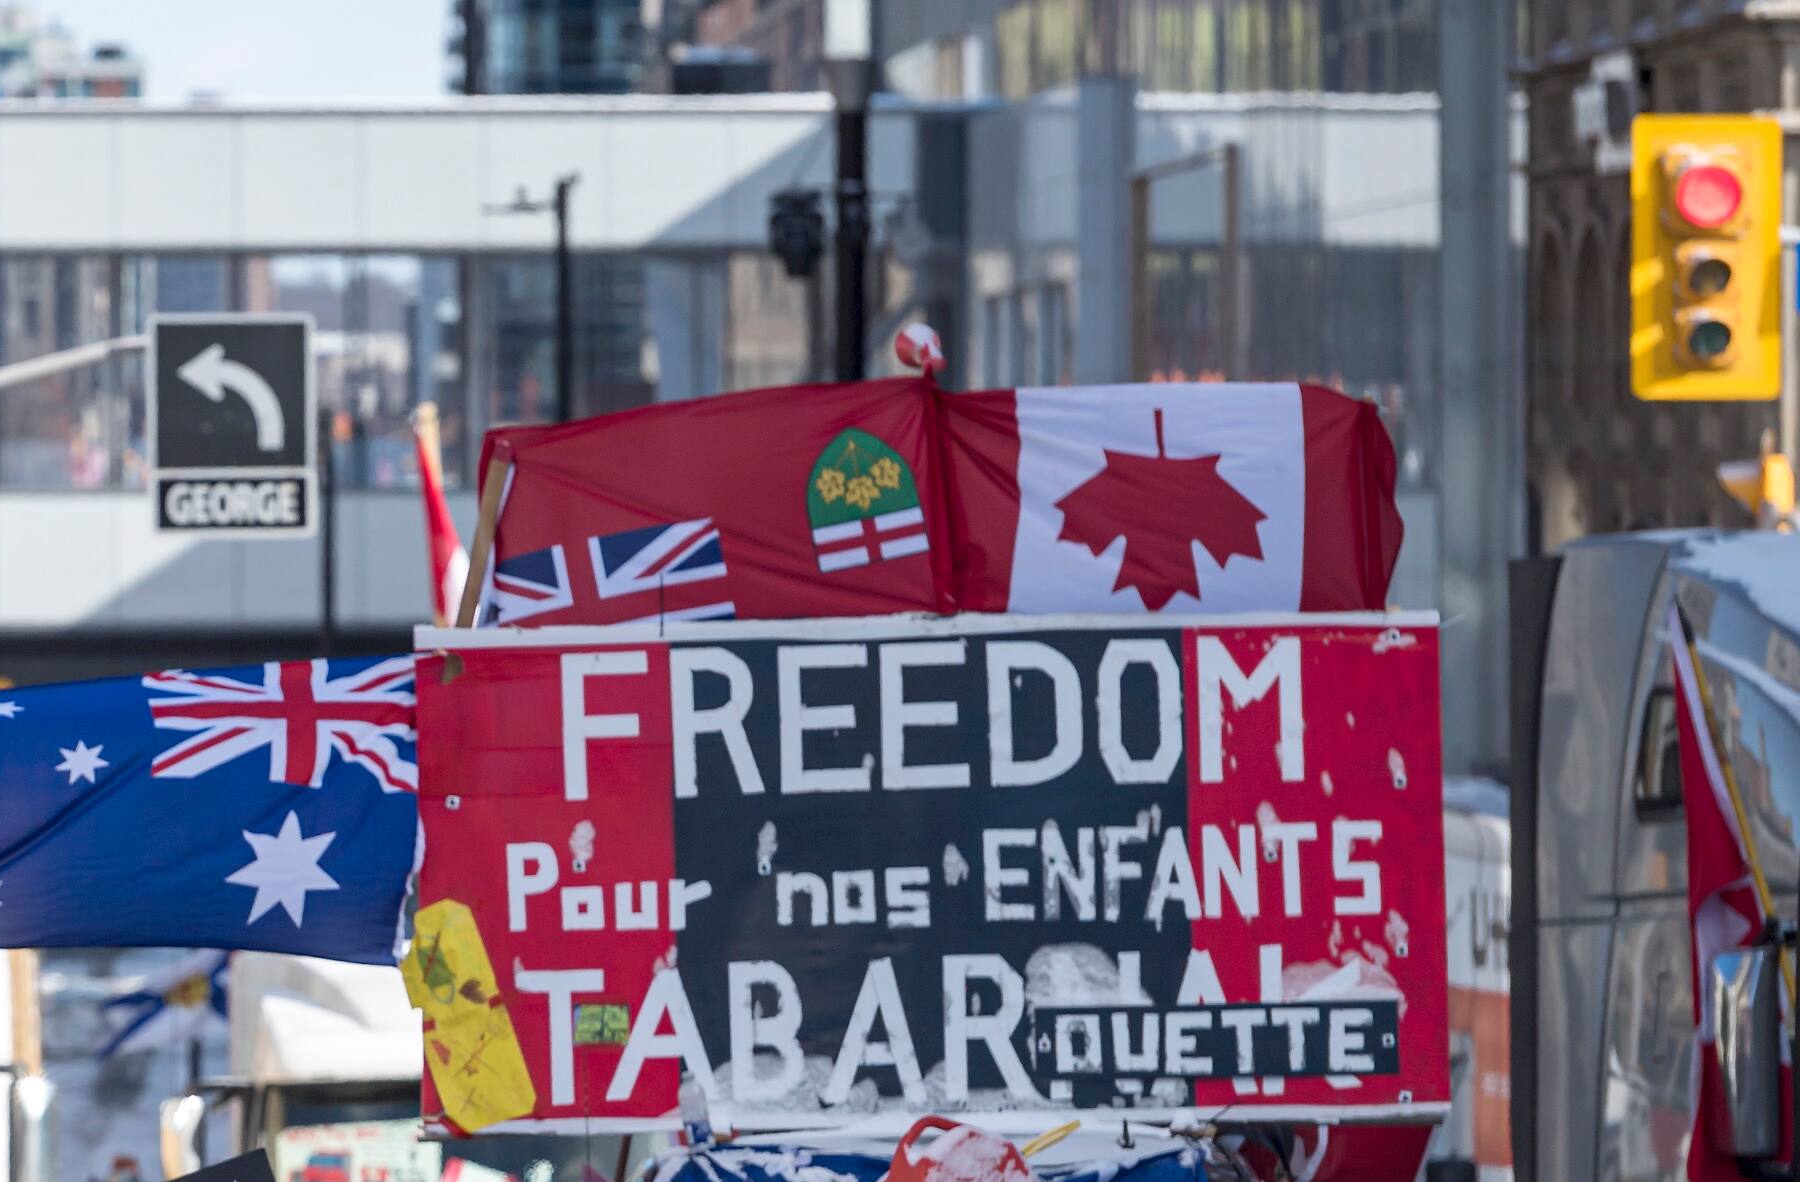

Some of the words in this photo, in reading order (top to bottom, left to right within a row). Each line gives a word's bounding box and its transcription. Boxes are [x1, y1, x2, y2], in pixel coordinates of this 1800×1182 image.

[165, 482, 301, 527] GEORGE
[560, 636, 1305, 802] FREEDOM
[506, 838, 713, 933] Pour
[775, 865, 932, 928] nos
[981, 819, 1384, 929] ENFANTS
